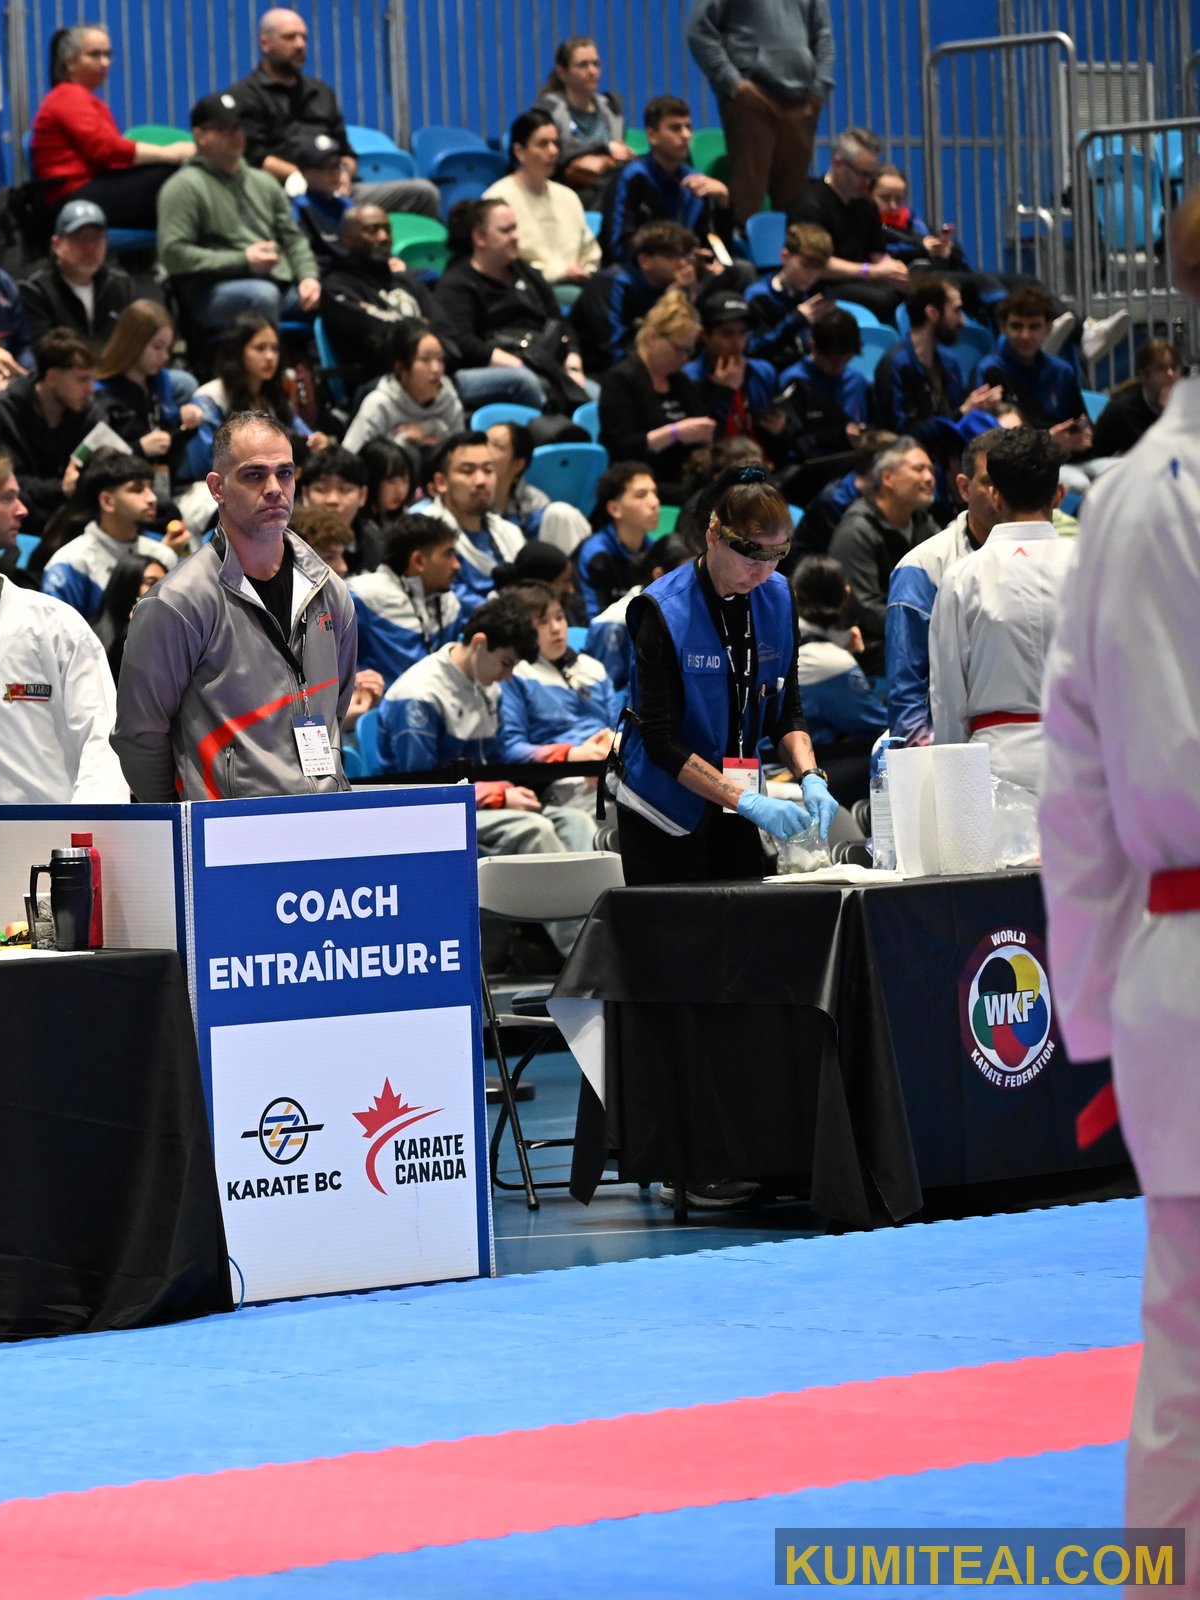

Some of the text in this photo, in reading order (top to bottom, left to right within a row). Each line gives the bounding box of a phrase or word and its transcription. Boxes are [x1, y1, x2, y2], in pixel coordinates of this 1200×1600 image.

[706, 655, 721, 669] AID
[276, 885, 398, 924] COACH
[991, 930, 1026, 947] WORLD
[984, 990, 1034, 1027] WKF
[970, 1039, 1056, 1088] KARATE FEDERATION
[394, 1134, 464, 1161] KARATE
[227, 1170, 342, 1201] KARATE BC
[395, 1158, 467, 1185] CANADA
